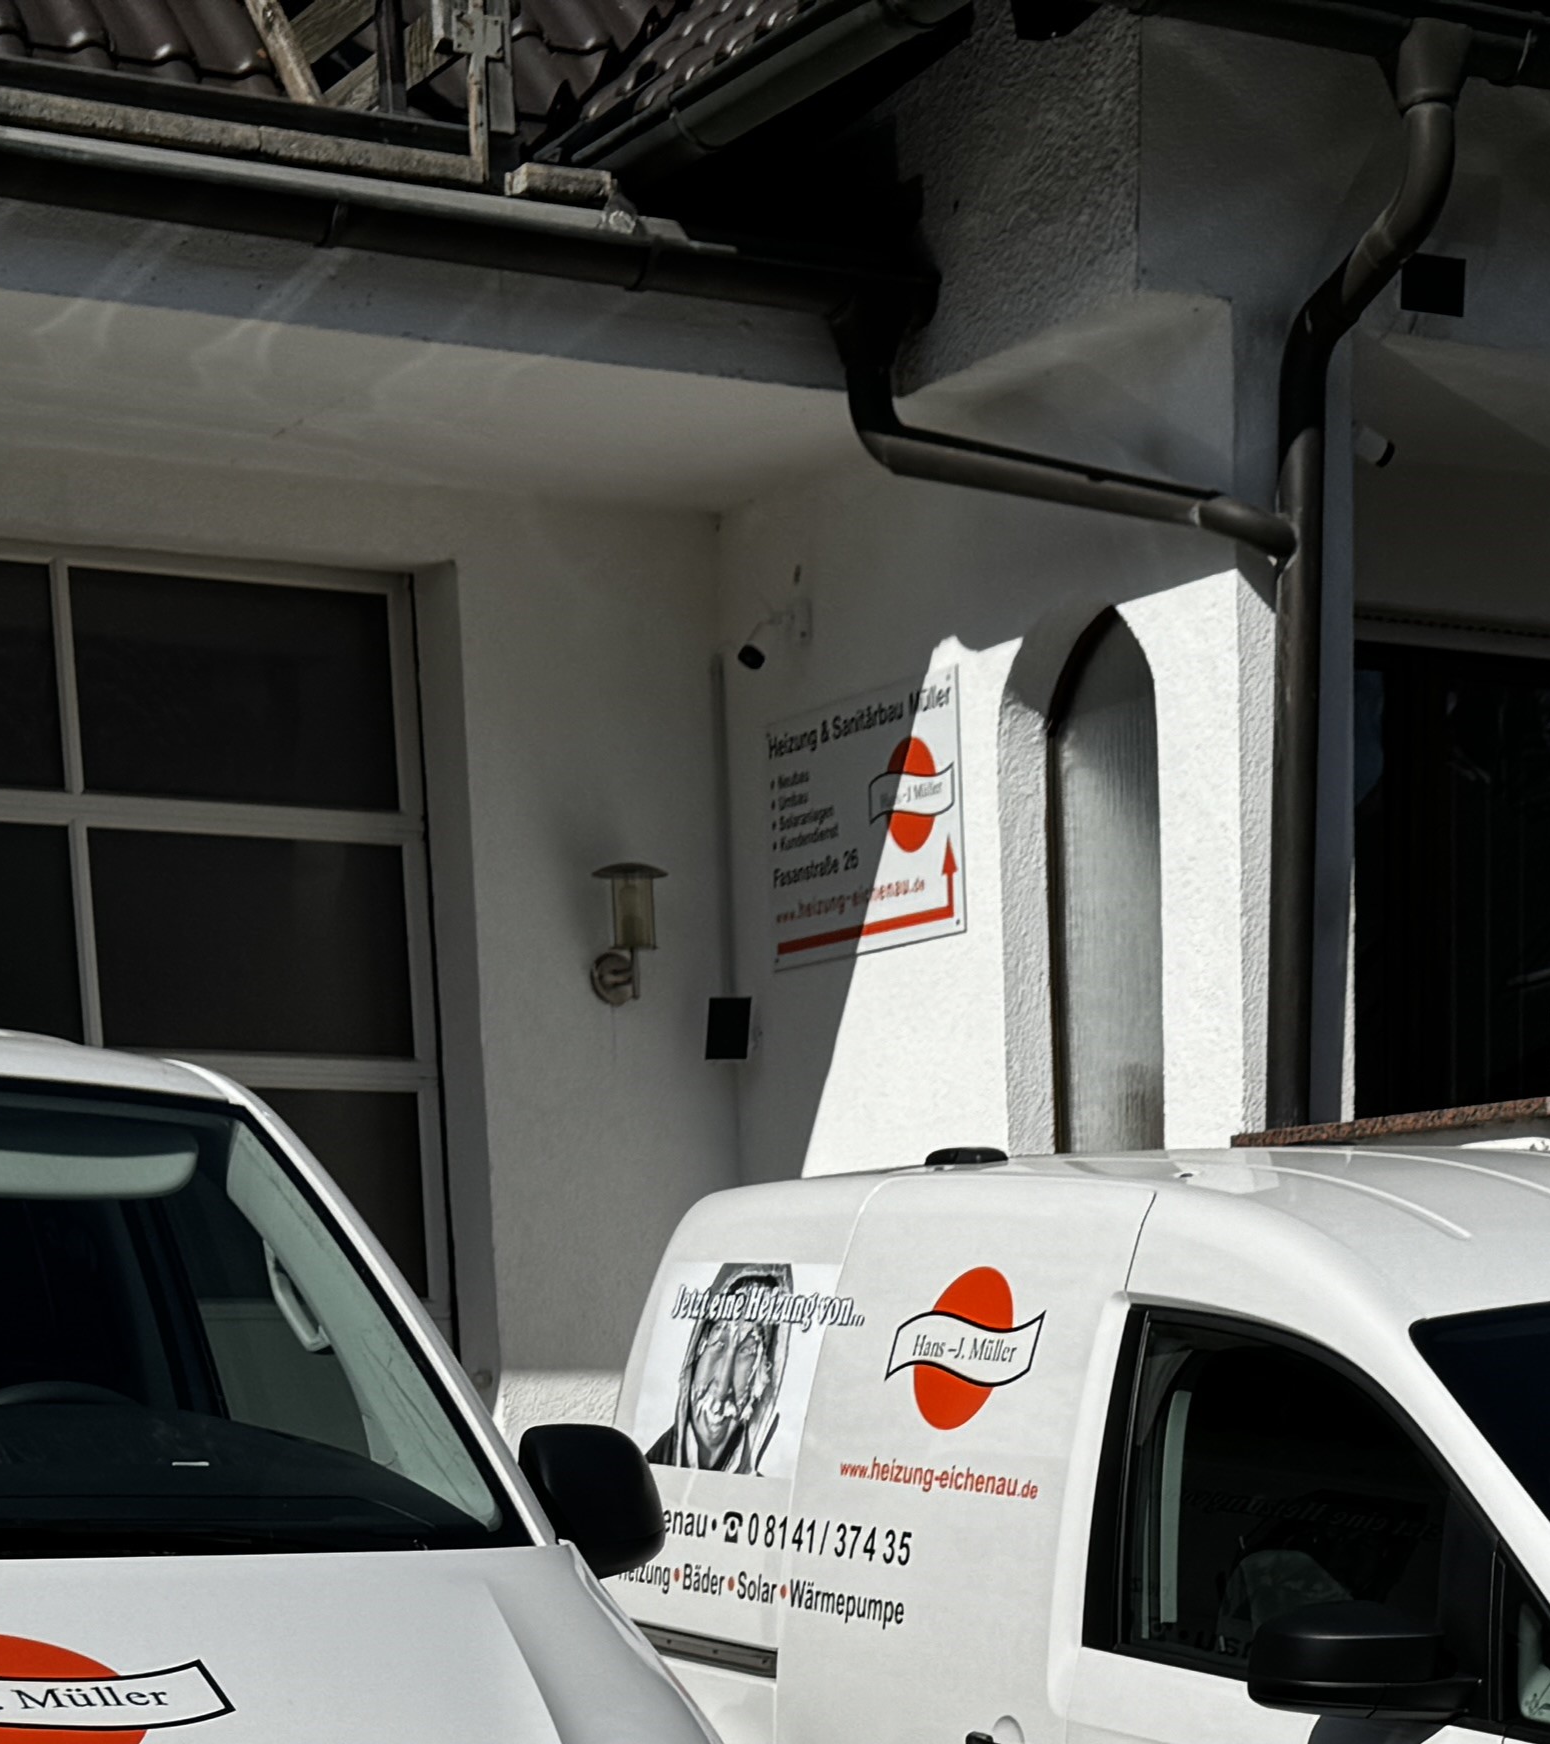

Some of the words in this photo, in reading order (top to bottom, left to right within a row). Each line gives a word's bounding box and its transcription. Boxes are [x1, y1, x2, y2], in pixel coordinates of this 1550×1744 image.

[768, 729, 818, 760] Heizung
[820, 719, 830, 744] &
[909, 685, 951, 716] Müller
[843, 848, 859, 872] 26
[671, 1284, 710, 1320] Jetzt
[709, 1289, 747, 1321] eine
[744, 1286, 820, 1333] Heizung
[912, 1334, 945, 1358] Hans
[970, 1336, 1018, 1364] Müller
[839, 1456, 1039, 1501] www.heizung-eichenau.de
[619, 1564, 670, 1595] eizung
[683, 1563, 725, 1596] Bäder
[737, 1571, 778, 1605] Solar
[790, 1579, 905, 1630] Wärmepumpe
[14, 1685, 171, 1711] Müller
